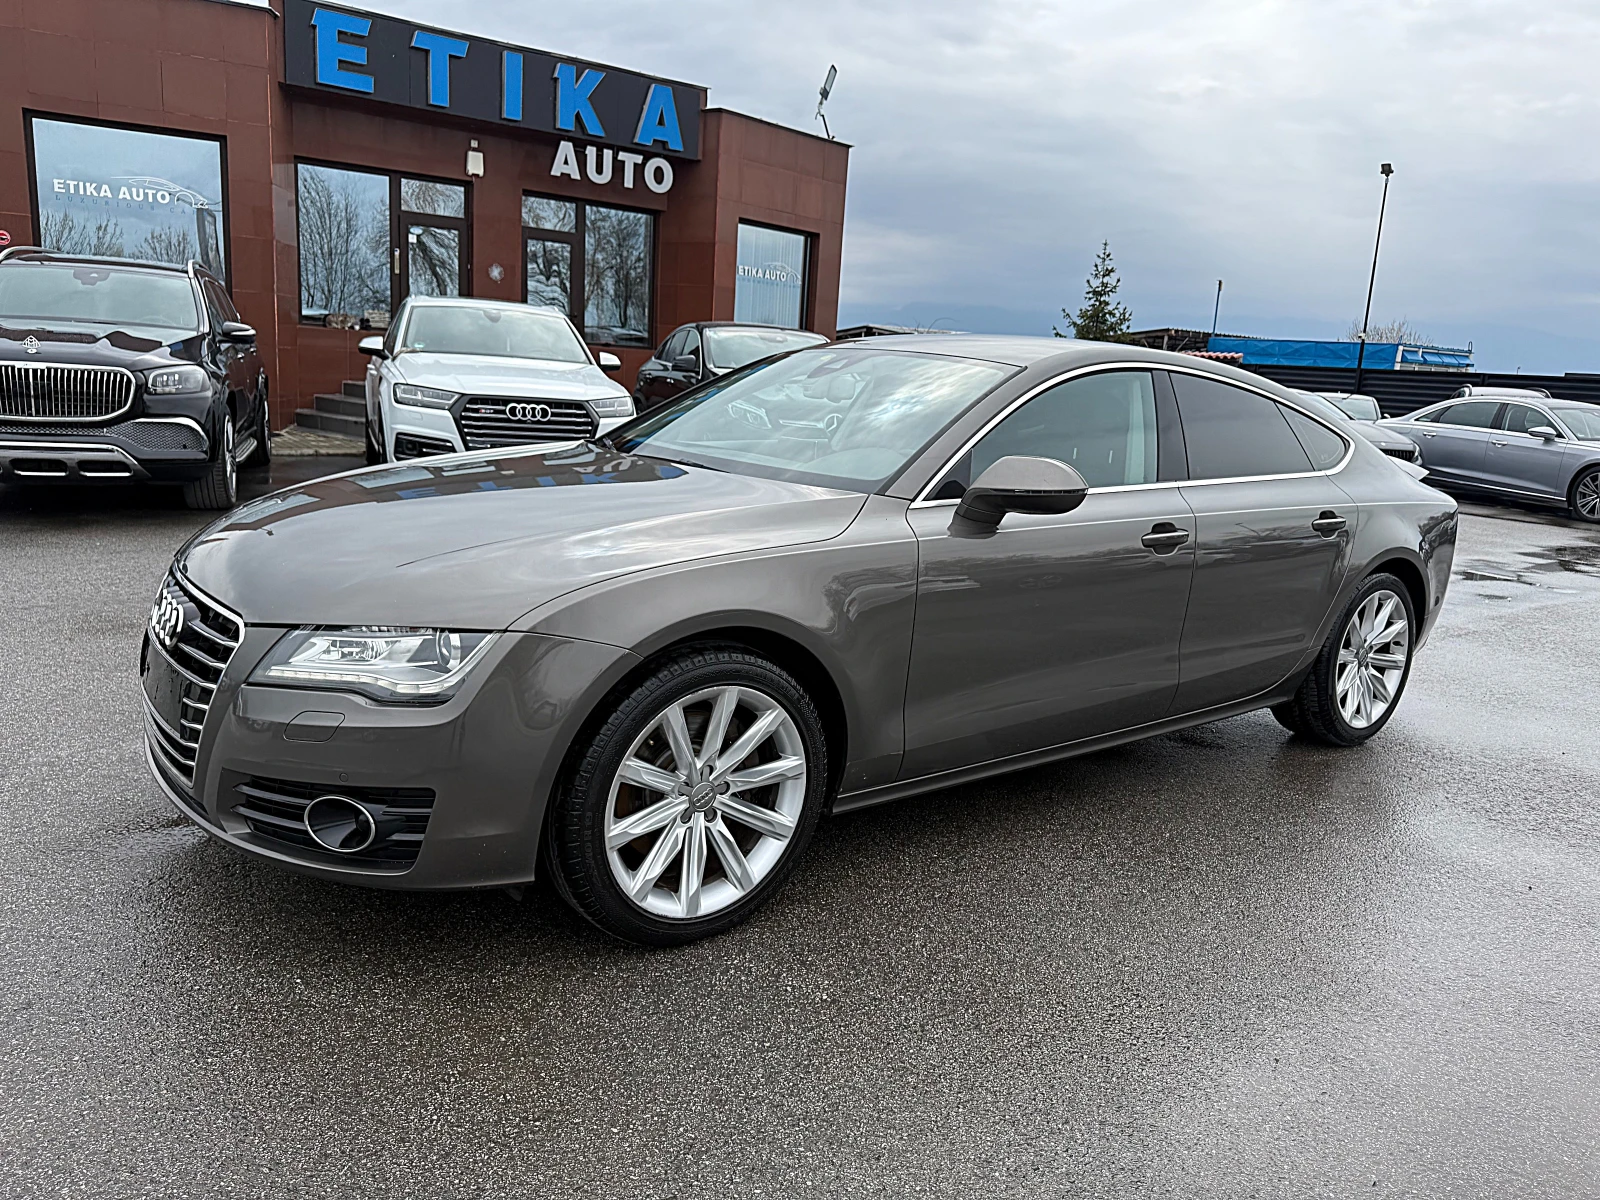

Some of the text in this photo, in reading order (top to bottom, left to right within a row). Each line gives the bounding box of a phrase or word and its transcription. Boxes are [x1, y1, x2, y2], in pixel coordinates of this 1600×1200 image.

[311, 7, 684, 152] ETIKA
[550, 141, 674, 194] AUTO
[53, 178, 170, 204] ETIKA AUTO
[738, 265, 787, 282] ETIKA AUTO
